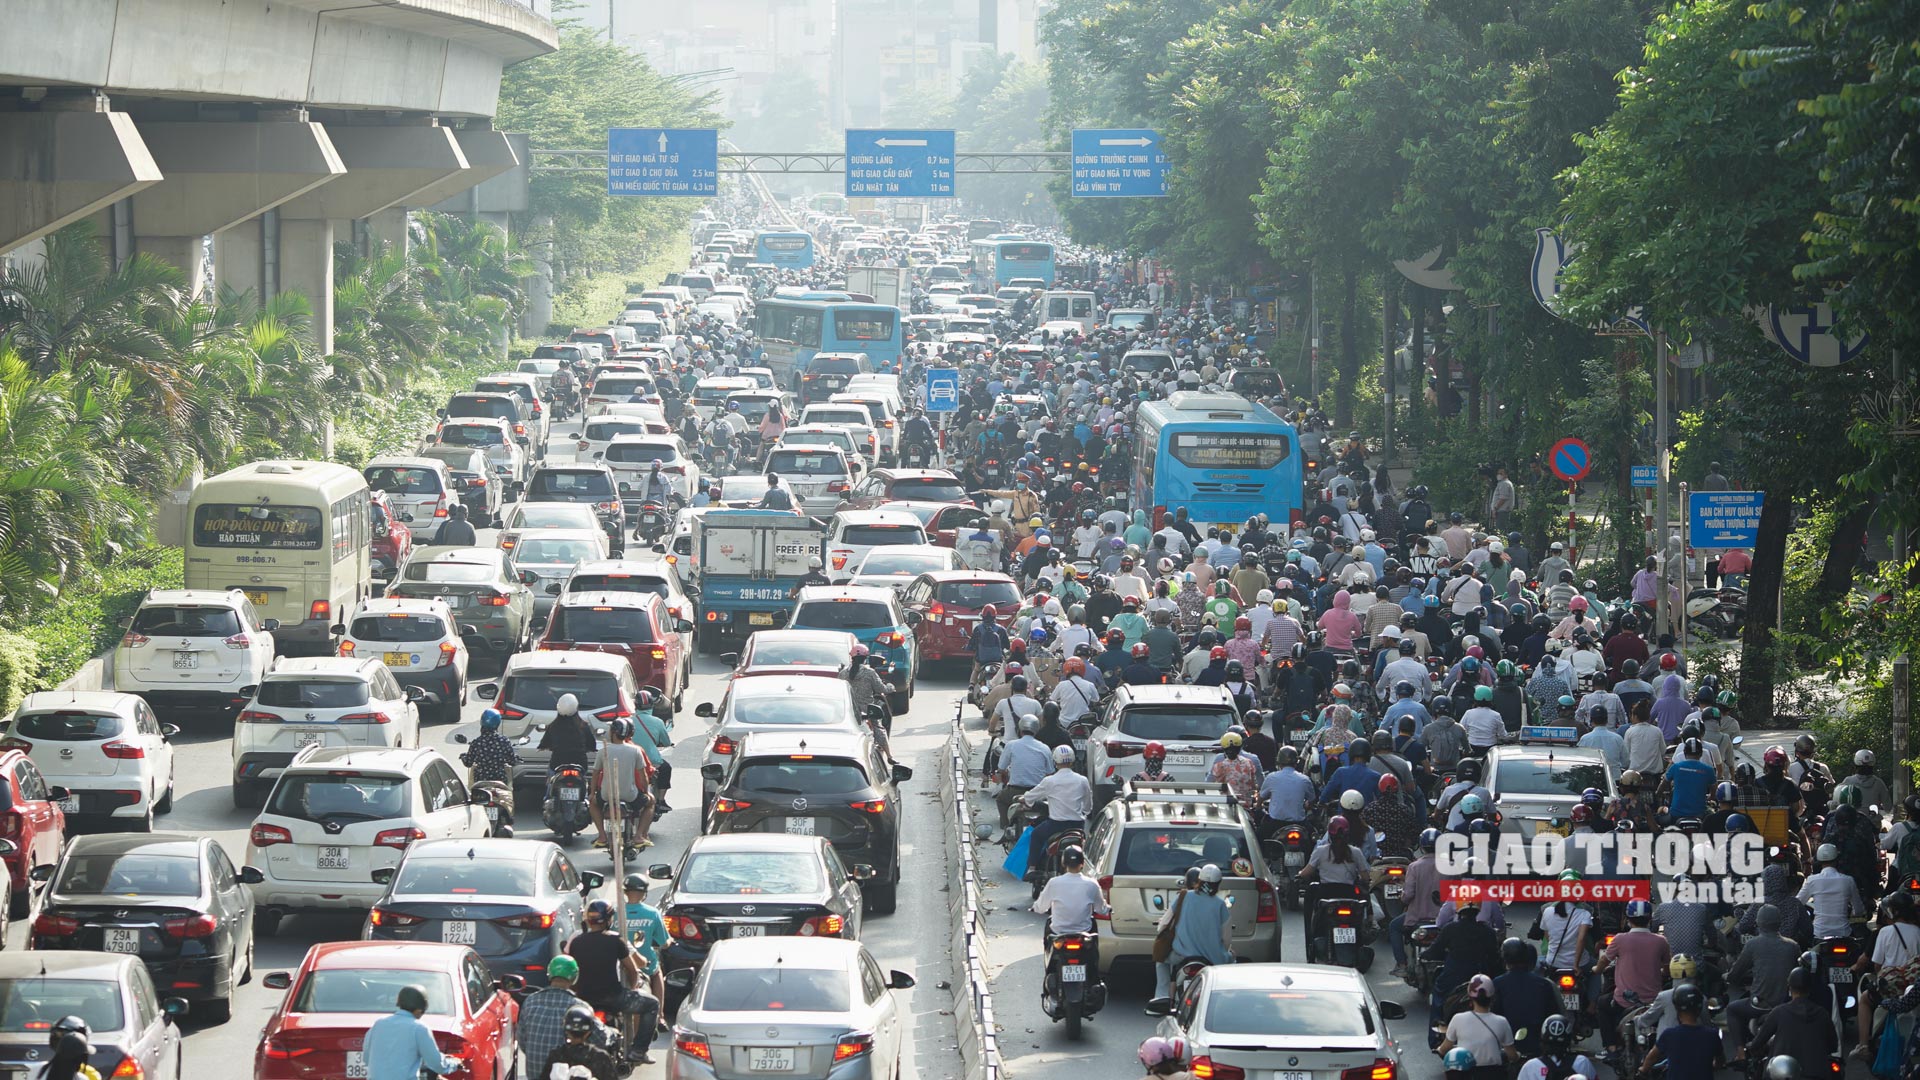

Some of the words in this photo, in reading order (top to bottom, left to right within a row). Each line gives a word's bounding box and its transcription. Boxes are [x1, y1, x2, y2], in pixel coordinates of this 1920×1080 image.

[625, 155, 640, 163] GIAO
[851, 154, 874, 164] ĐƯỜNG
[875, 154, 893, 164] LÁNG
[938, 156, 950, 165] km
[1075, 153, 1098, 164] ĐƯỜNG
[1101, 152, 1127, 164] TRƯỜNG
[1128, 155, 1148, 163] CHINH
[611, 166, 624, 177] NÚT
[625, 168, 640, 177] GIAO
[692, 169, 703, 178] 2,5
[704, 168, 715, 177] km
[851, 167, 864, 178] NÚT
[866, 169, 881, 178] GIAO
[932, 169, 938, 178] 5
[938, 169, 950, 178] km
[1075, 167, 1089, 178] NÚT
[1090, 169, 1106, 178] GIAO
[672, 181, 689, 191] GIÁM
[692, 182, 703, 191] 4,3
[704, 182, 715, 191] km
[851, 181, 864, 192] CẦU
[886, 182, 899, 192] TÂN
[930, 183, 937, 192] 11
[938, 183, 950, 192] km
[1075, 181, 1089, 192] CẦU
[1109, 183, 1121, 191] TUY
[1633, 467, 1650, 478] NGÕ
[1700, 507, 1713, 517] BAN
[1713, 504, 1724, 517] CHỈ
[1724, 506, 1737, 517] HUY
[1737, 505, 1754, 518] QUÂN
[262, 521, 280, 533] DU
[1704, 517, 1726, 529] PHƯỜNG
[219, 532, 235, 543] HẢO
[236, 532, 260, 544] THUẬN
[775, 545, 797, 555] FREE
[739, 588, 783, 600] 29H-407.29
[1541, 728, 1558, 737] SÔNG
[1163, 755, 1201, 764] 0H-439.25
[792, 817, 808, 827] 30F
[325, 847, 342, 858] 30A
[318, 858, 348, 868] 806.48
[450, 921, 468, 932] 88A
[739, 926, 759, 937] 30V
[113, 930, 131, 941] 29A
[444, 933, 474, 944] 122.44
[105, 942, 138, 952] 479.00
[762, 1048, 782, 1059] 30G
[755, 1059, 790, 1070] 797.07
[347, 1065, 368, 1077] 385
